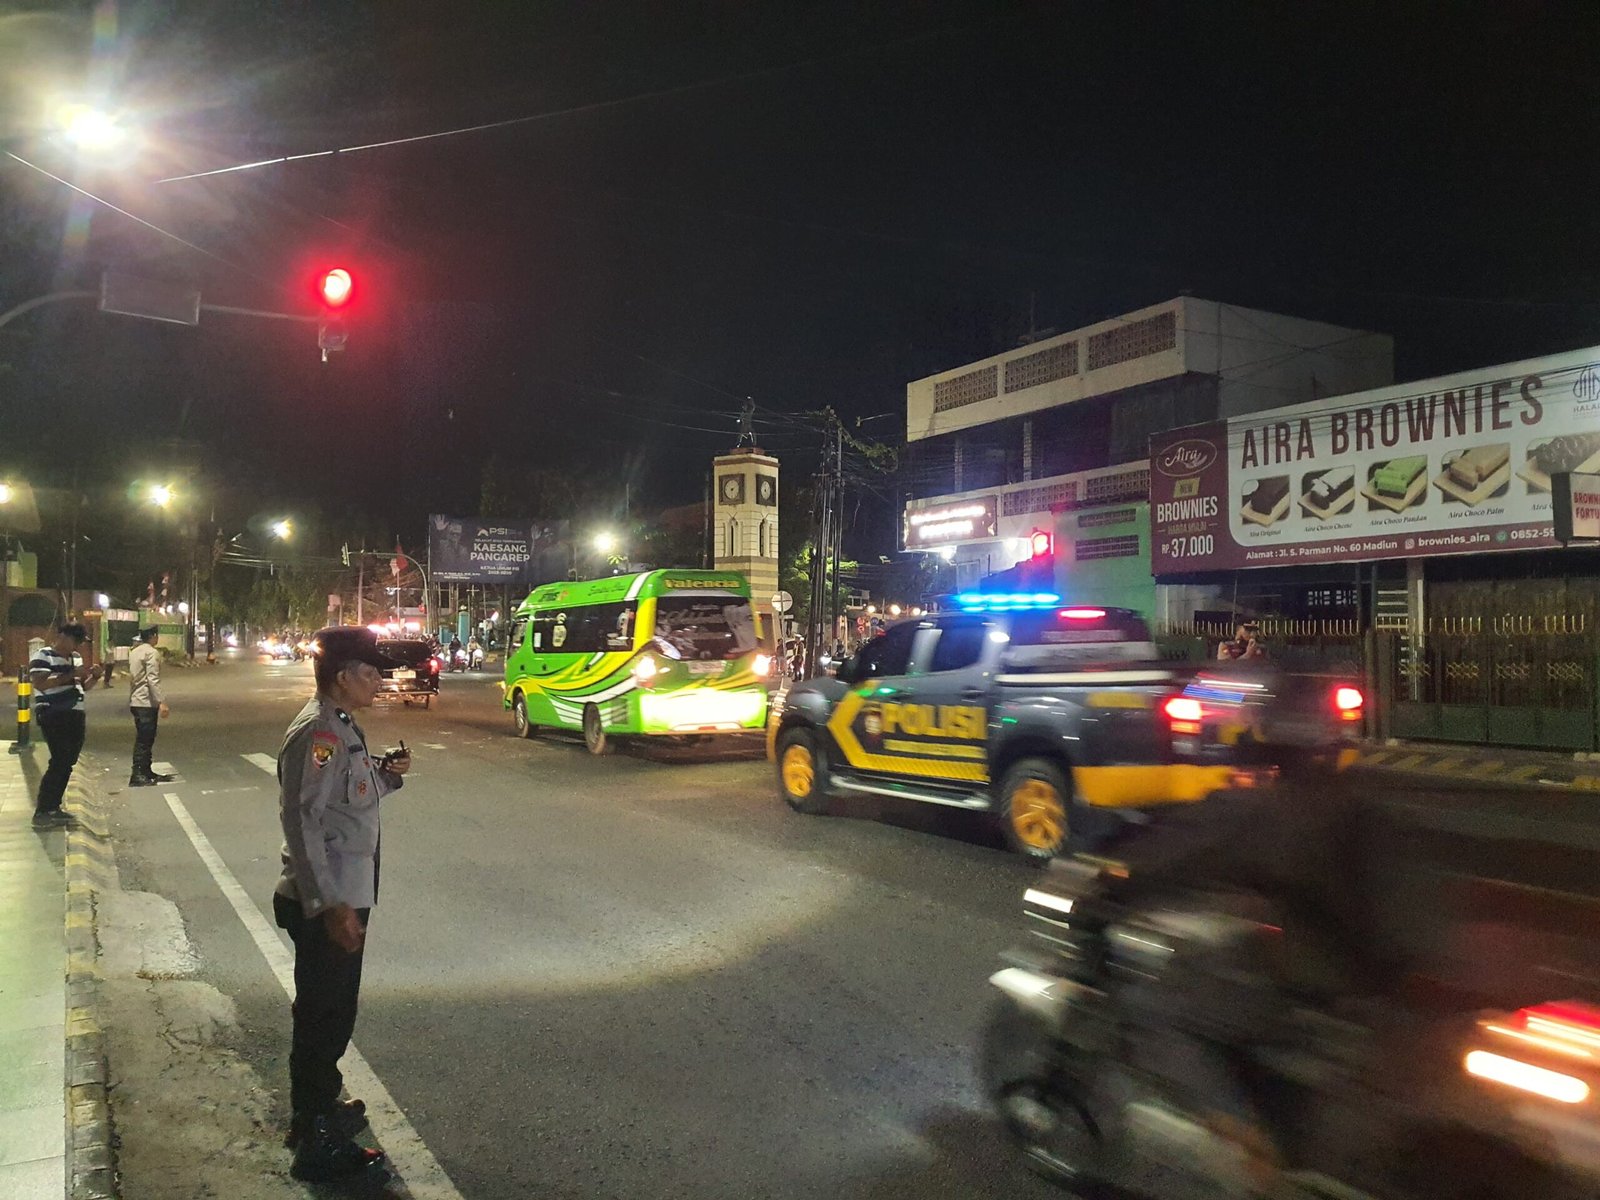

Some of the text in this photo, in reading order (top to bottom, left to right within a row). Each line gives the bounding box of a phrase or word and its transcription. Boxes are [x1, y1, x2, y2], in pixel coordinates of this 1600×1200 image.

[1242, 375, 1543, 469] AIRA BROWNIES
[1157, 496, 1218, 523] BROWNIES
[489, 527, 508, 536] PSI
[1418, 532, 1491, 546] brownies_aira
[473, 543, 527, 553] KAESANG
[1171, 535, 1214, 558] 37.000
[1246, 551, 1274, 560] Alamat
[1299, 546, 1331, 556] Parman
[1333, 545, 1348, 553] No.
[1350, 543, 1361, 551] 60
[1362, 540, 1398, 551] Madiun
[470, 552, 530, 562] PANGAREP
[664, 579, 740, 589] Valencia
[882, 702, 988, 740] POLISI
